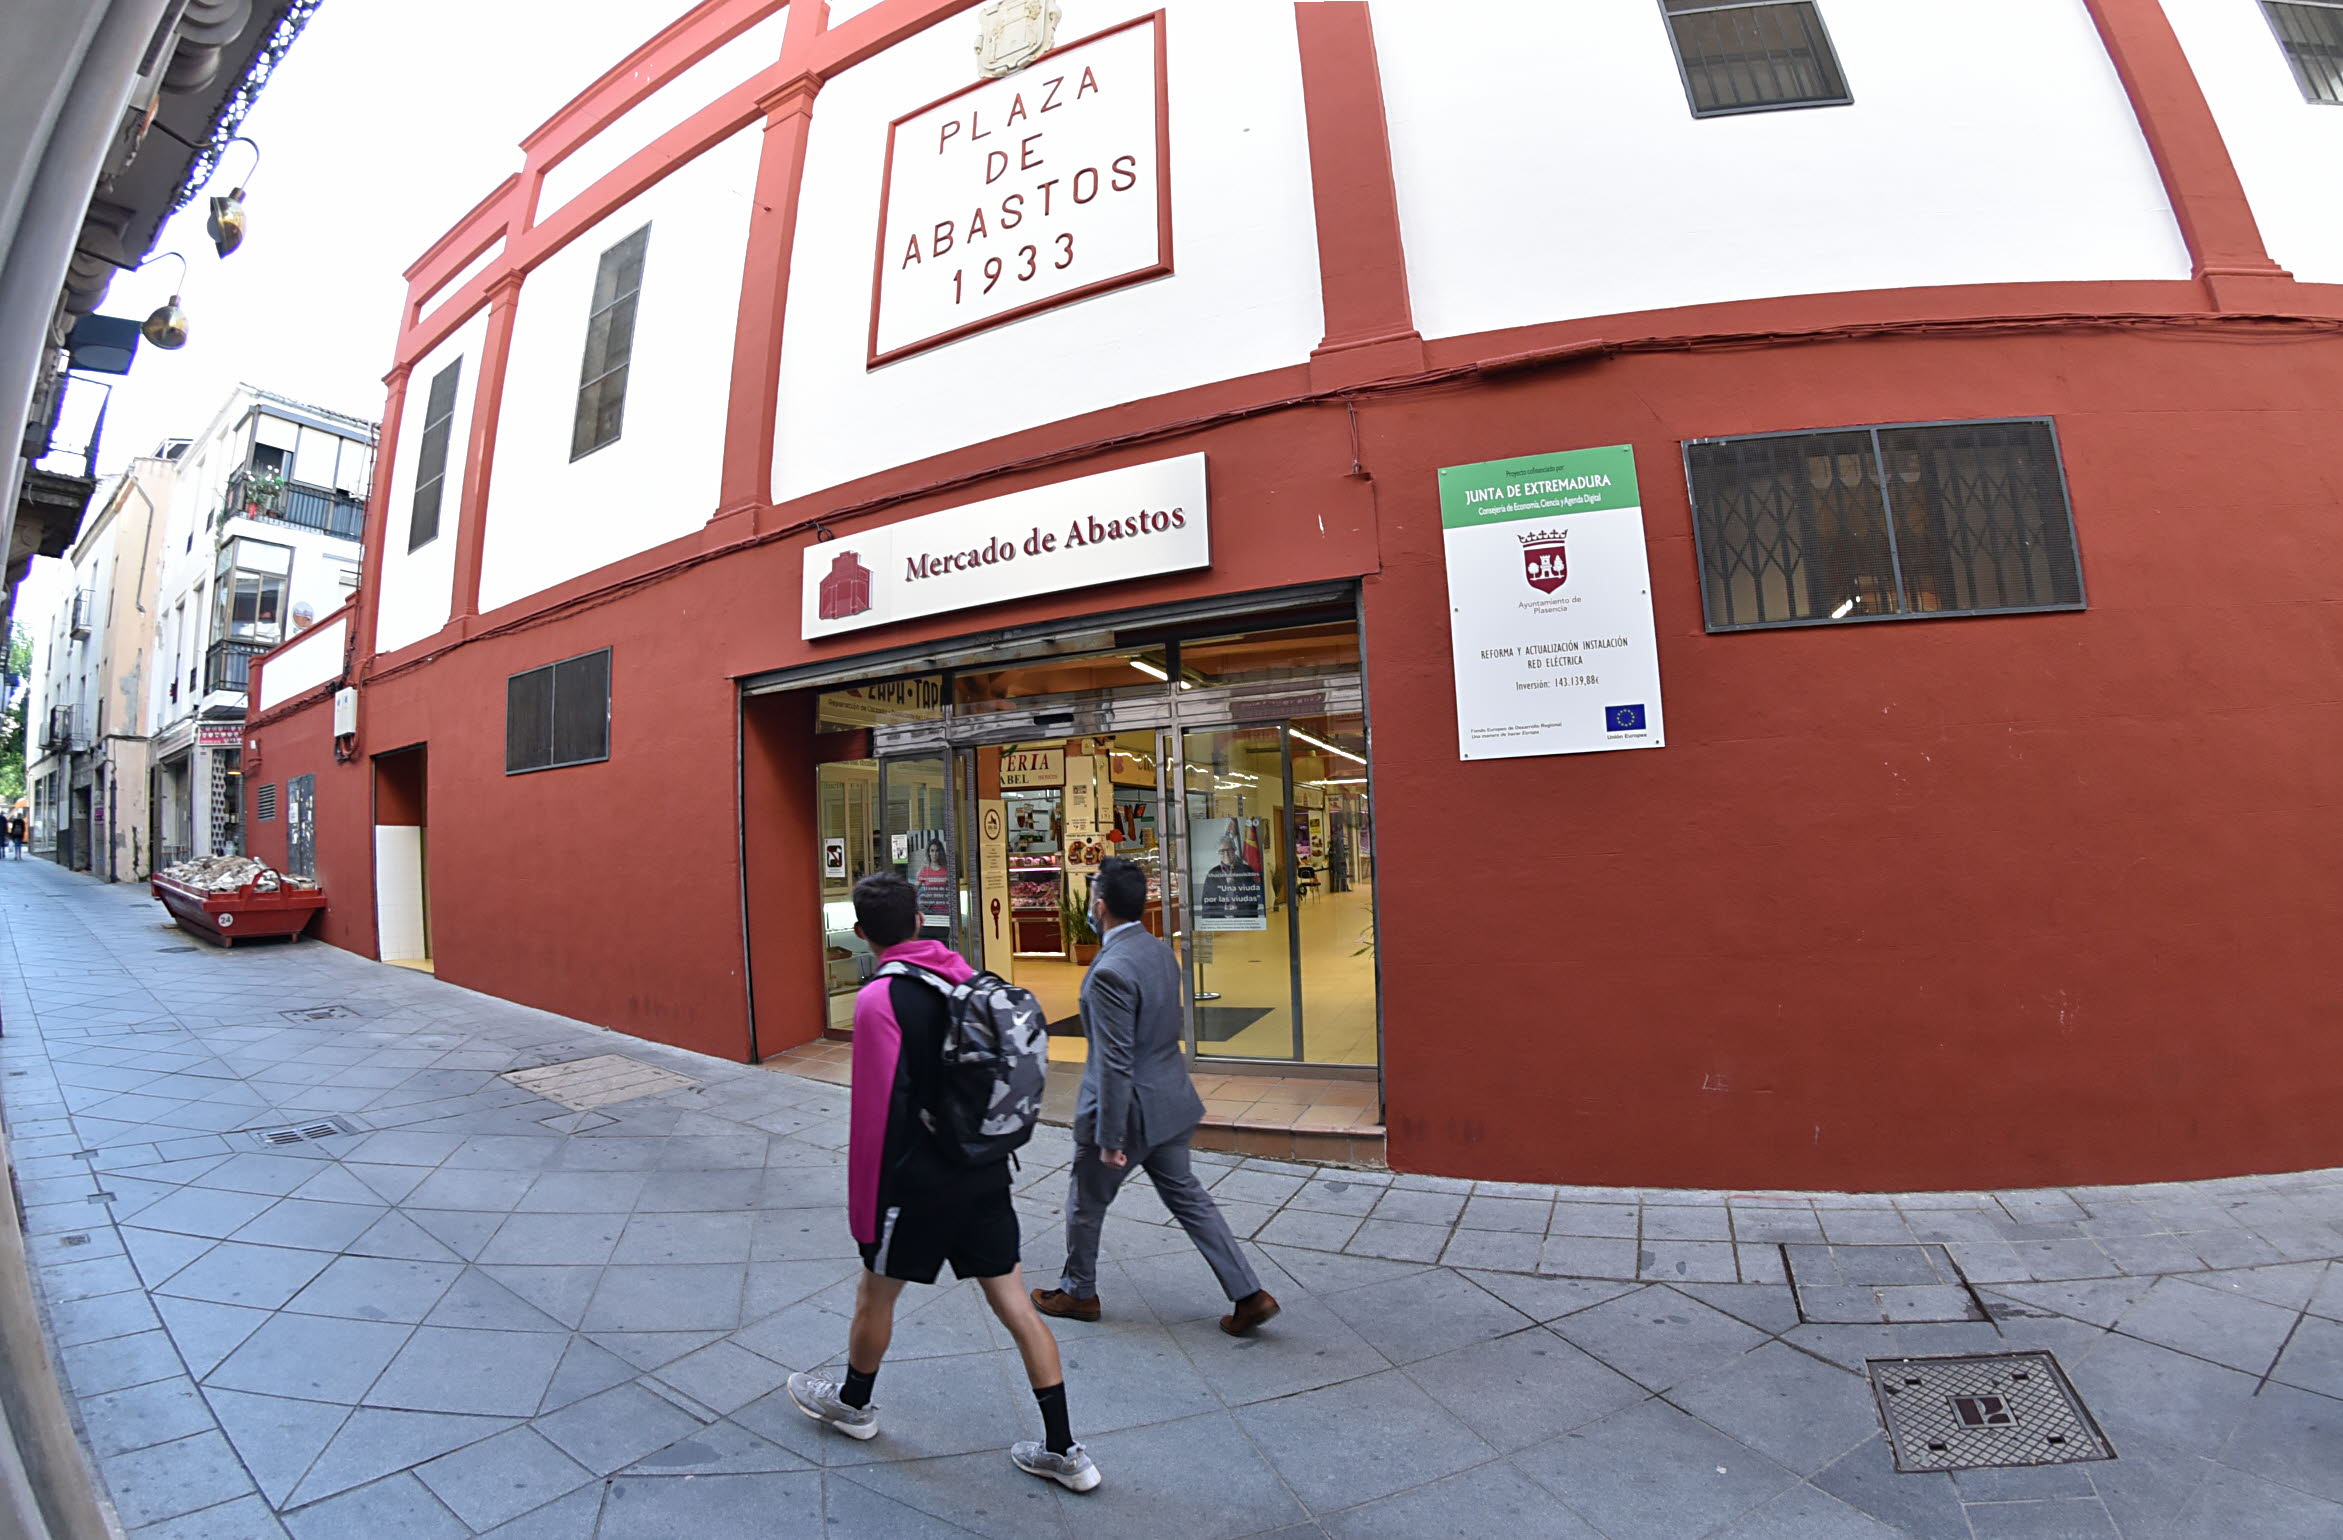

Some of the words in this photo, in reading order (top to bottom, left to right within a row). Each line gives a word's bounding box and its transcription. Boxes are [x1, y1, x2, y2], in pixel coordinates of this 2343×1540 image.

[938, 65, 1099, 155] PLAZA
[985, 132, 1044, 185] DE
[901, 154, 1137, 270] ABASTOS
[952, 232, 1074, 304] 1933
[1506, 468, 1526, 478] Proyecto
[1556, 464, 1565, 473] por
[1465, 487, 1504, 505] JUNTA
[1507, 484, 1522, 498] DE
[1524, 474, 1612, 496] EXTREMADURA
[1478, 504, 1506, 516] Consejería
[1506, 502, 1514, 512] de
[1540, 497, 1560, 508] Ciencia
[1564, 496, 1584, 507] Agenda
[1584, 493, 1602, 504] Digital
[904, 536, 1016, 582] Mercado
[1023, 526, 1056, 556] de
[1065, 504, 1185, 549] Abastos
[1518, 597, 1570, 609] Ayuntamiento
[1533, 605, 1568, 614] Plasencia
[1480, 648, 1514, 660] REFORMA
[1517, 647, 1522, 656] Y
[1526, 640, 1578, 656] ACTUALIZACIÓN
[1583, 636, 1628, 650] INSTALACIÓN
[1528, 659, 1542, 669] RED
[1546, 655, 1583, 668] ELÉCTRICA
[1516, 680, 1550, 691] Inversión:
[1555, 674, 1600, 687] 143.139,88€
[1624, 732, 1648, 740] Europea
[1238, 884, 1261, 892] viuda
[1204, 896, 1217, 904] por
[220, 915, 231, 925] 24
